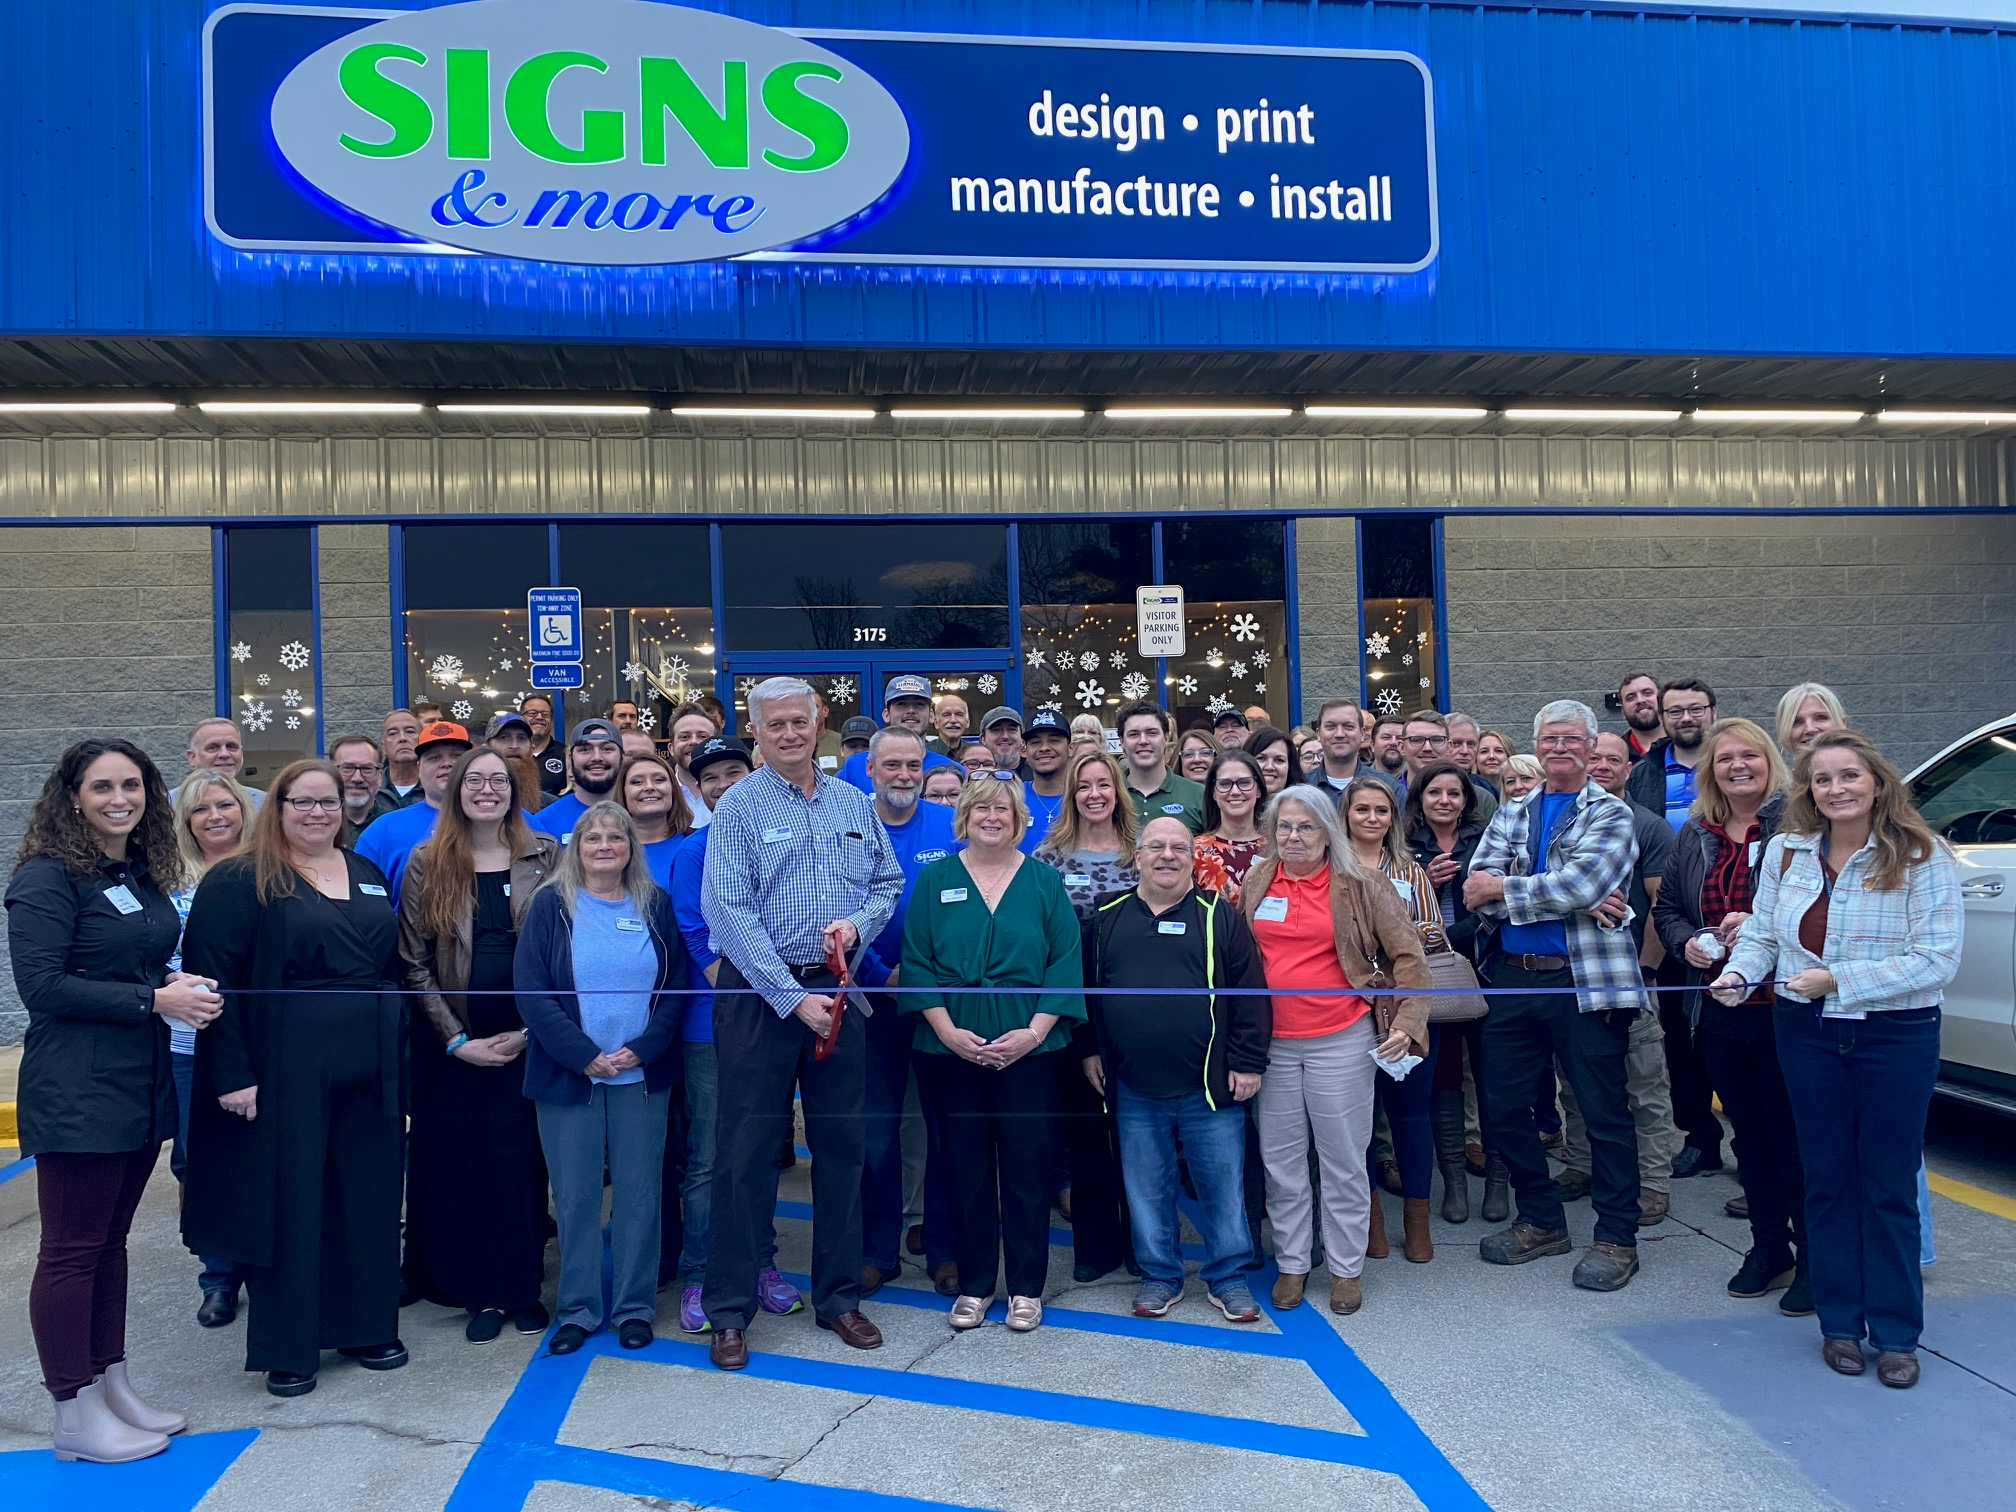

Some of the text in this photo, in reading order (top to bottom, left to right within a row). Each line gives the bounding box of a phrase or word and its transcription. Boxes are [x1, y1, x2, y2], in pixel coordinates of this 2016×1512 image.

[338, 42, 851, 173] SIGNS
[1028, 89, 1315, 154] design print
[950, 167, 1393, 222] manufacture install
[430, 169, 768, 235] & more
[1146, 612, 1176, 620] VISITOR
[853, 628, 887, 642] 3175
[1144, 624, 1180, 632] PARKING
[1152, 636, 1173, 644] ONLY
[916, 850, 946, 860] SIGNS
